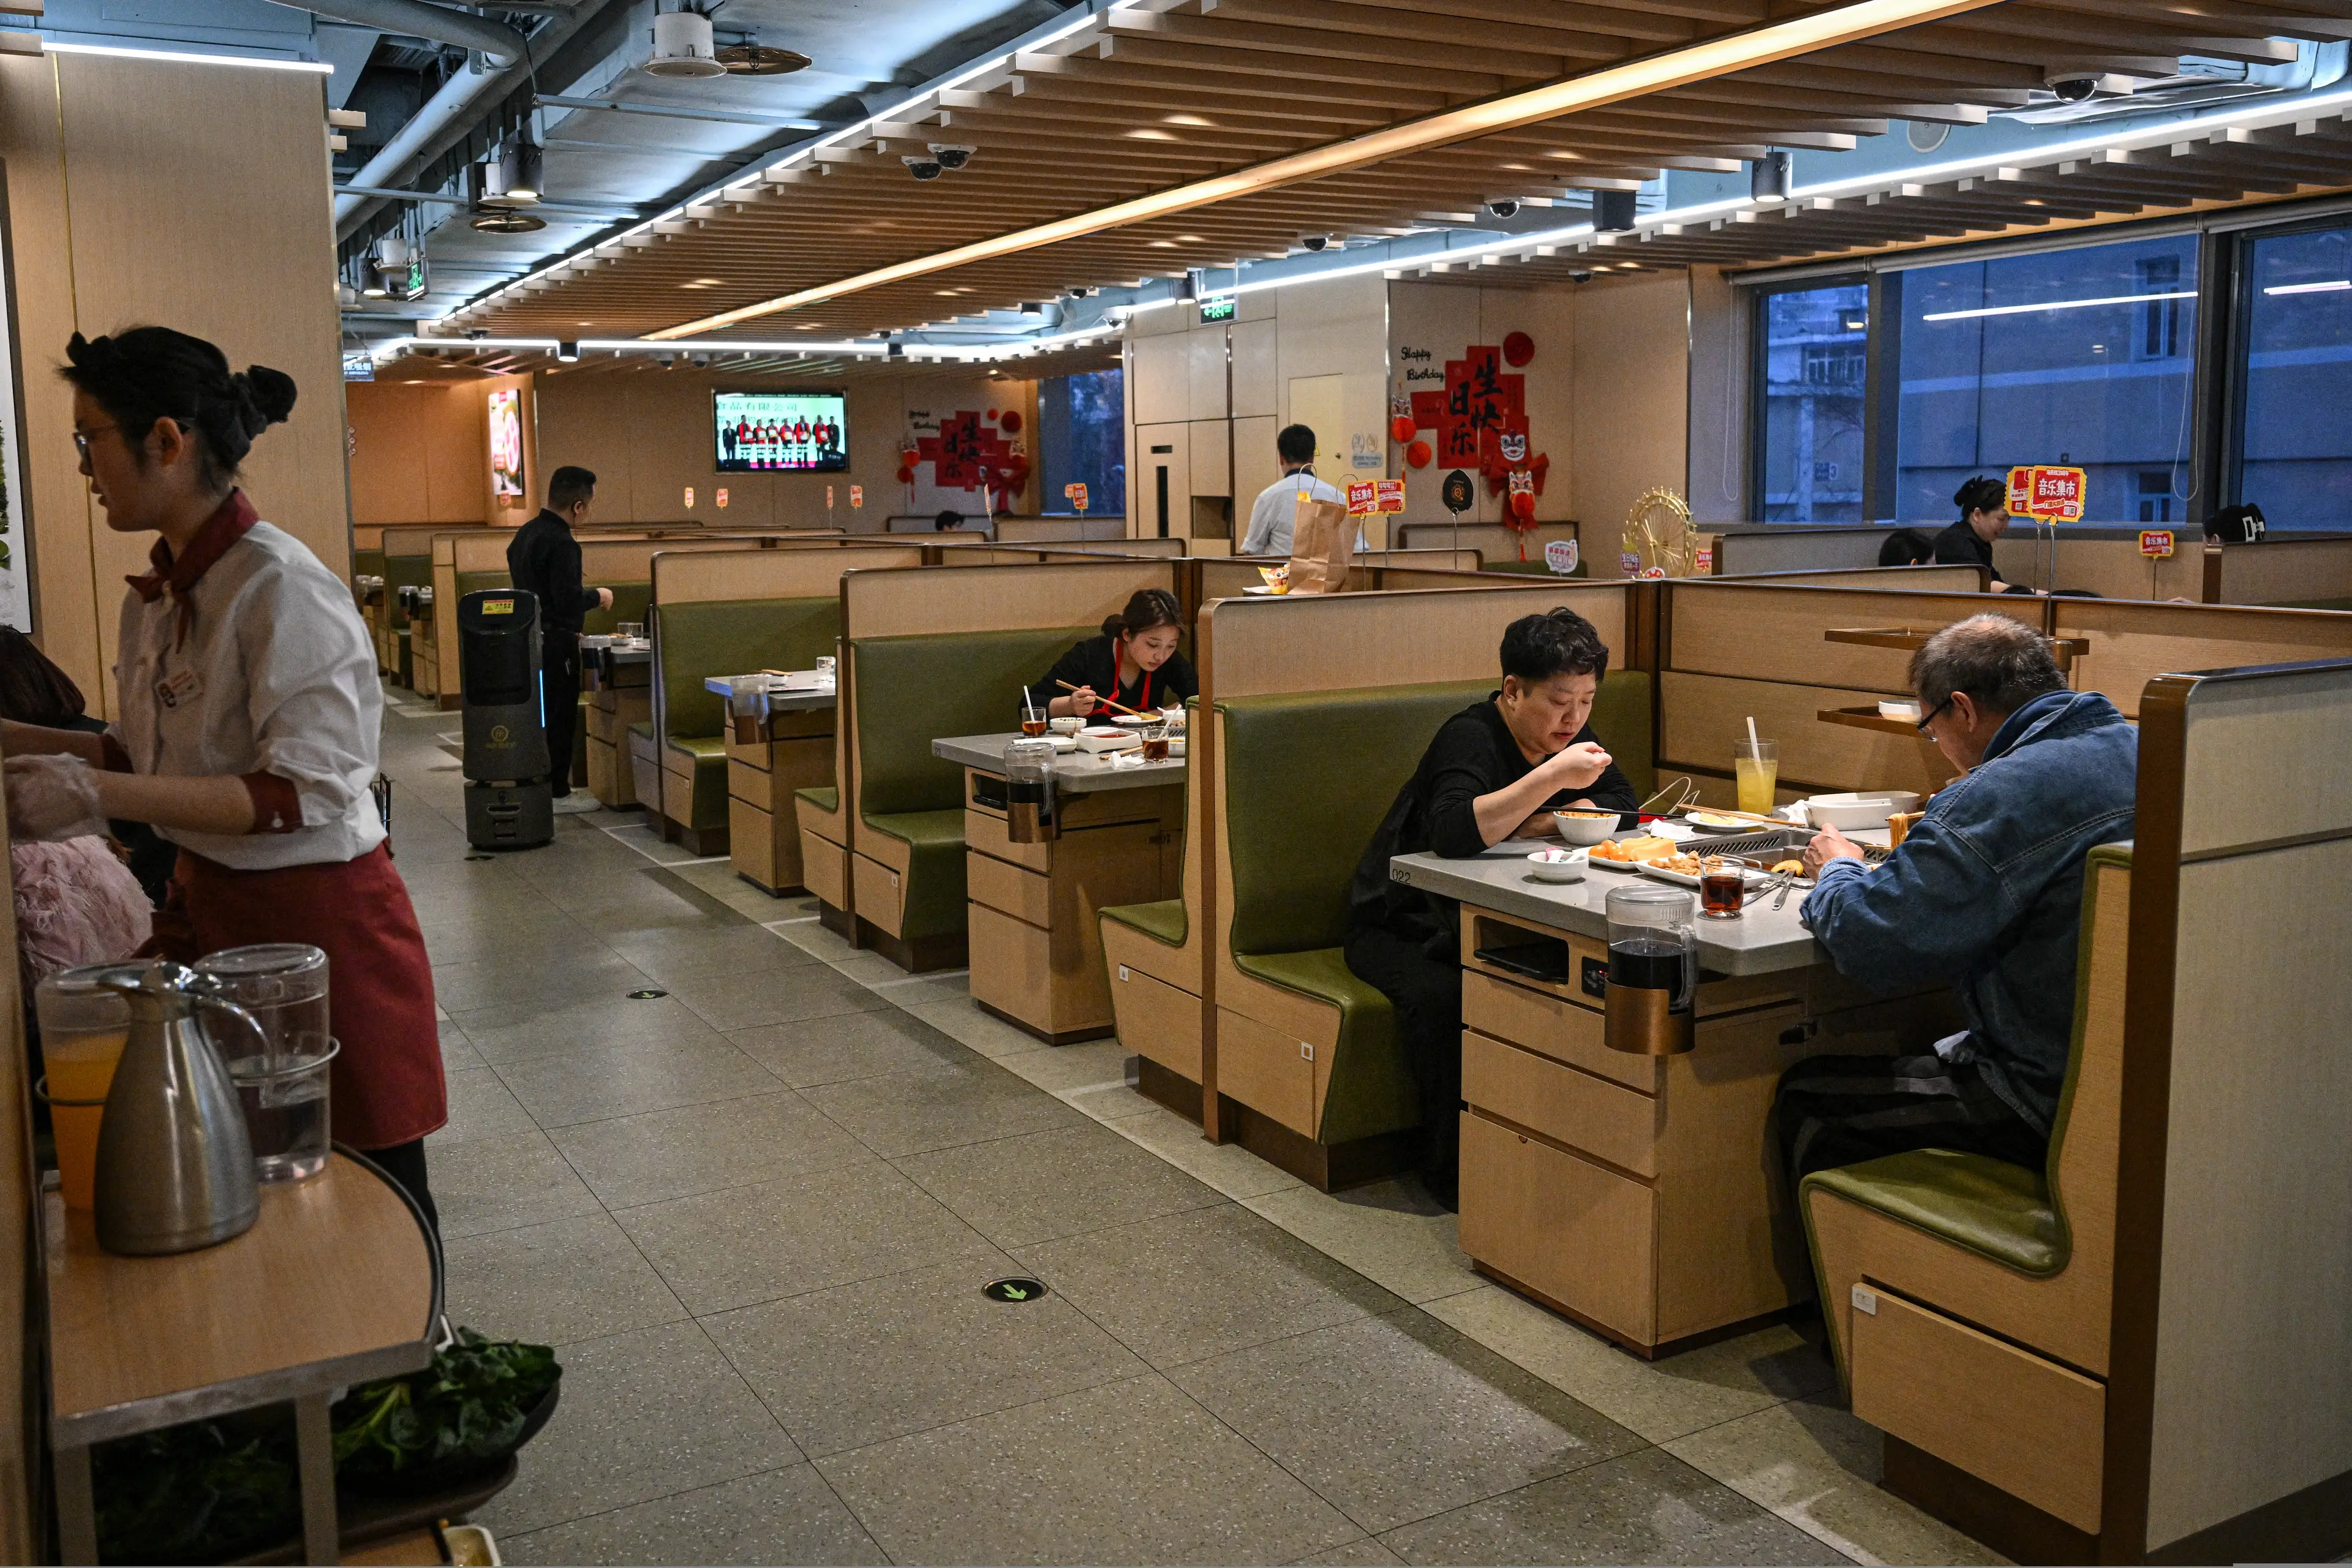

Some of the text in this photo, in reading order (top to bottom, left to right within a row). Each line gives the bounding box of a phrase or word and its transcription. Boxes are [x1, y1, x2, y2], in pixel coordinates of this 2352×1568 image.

[1401, 347, 1431, 361] Happy
[1407, 368, 1446, 382] Birthday
[2038, 478, 2076, 497] 音乐集市
[1351, 488, 1373, 502] 音乐集市
[1392, 868, 1411, 885] 022
